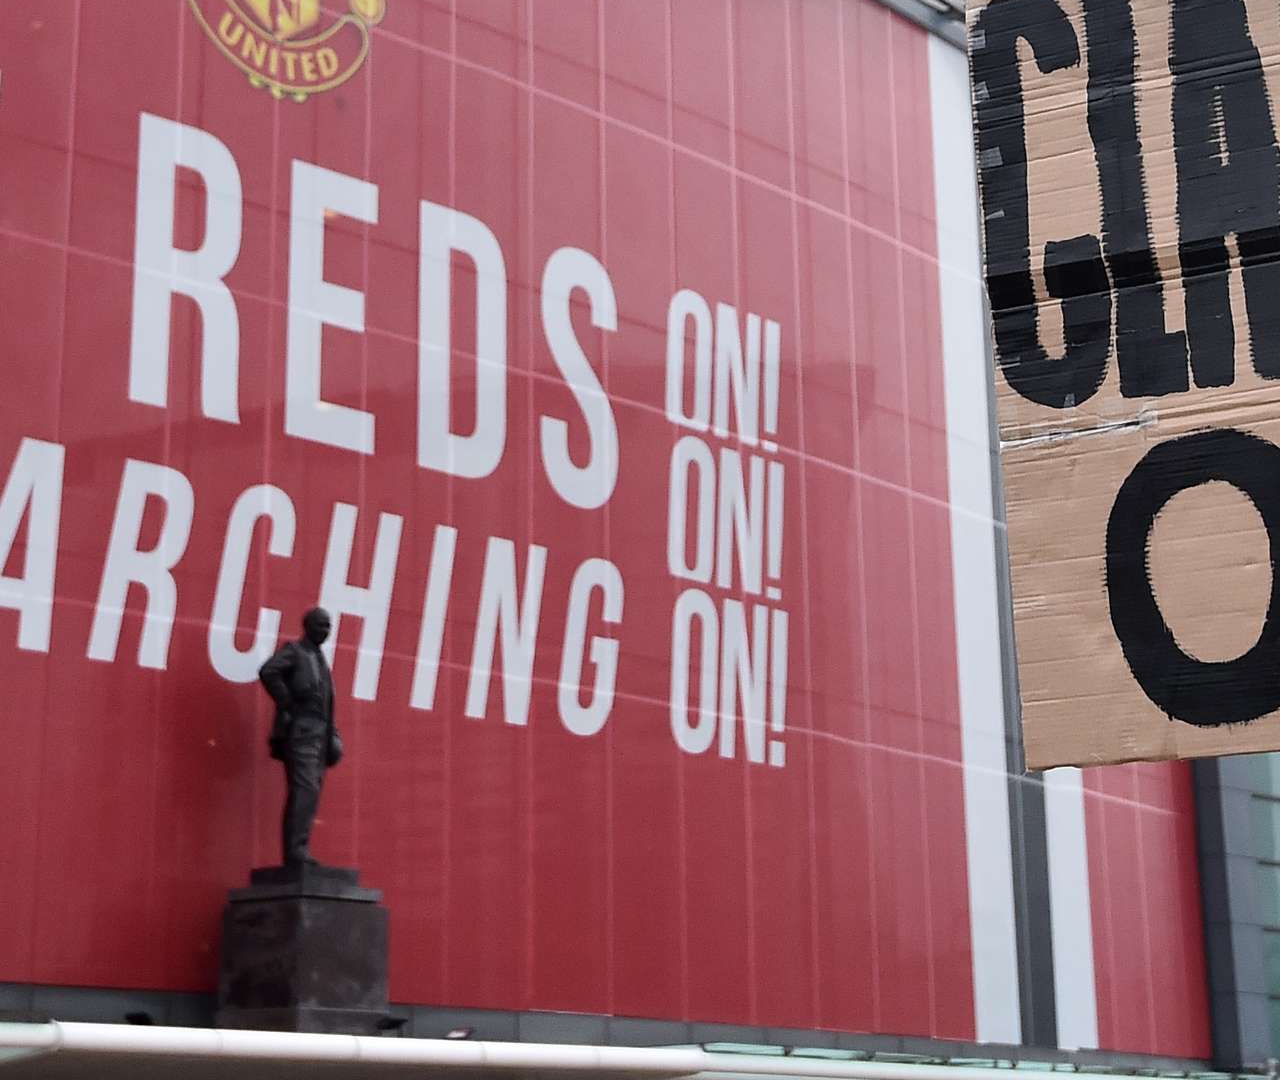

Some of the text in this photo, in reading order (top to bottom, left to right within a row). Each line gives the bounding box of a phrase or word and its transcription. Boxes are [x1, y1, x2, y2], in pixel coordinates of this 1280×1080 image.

[219, 12, 339, 82] UNITED
[128, 112, 618, 510] REDS
[666, 289, 782, 452] ON!
[667, 436, 785, 601] ON!
[670, 588, 789, 768] ON!
